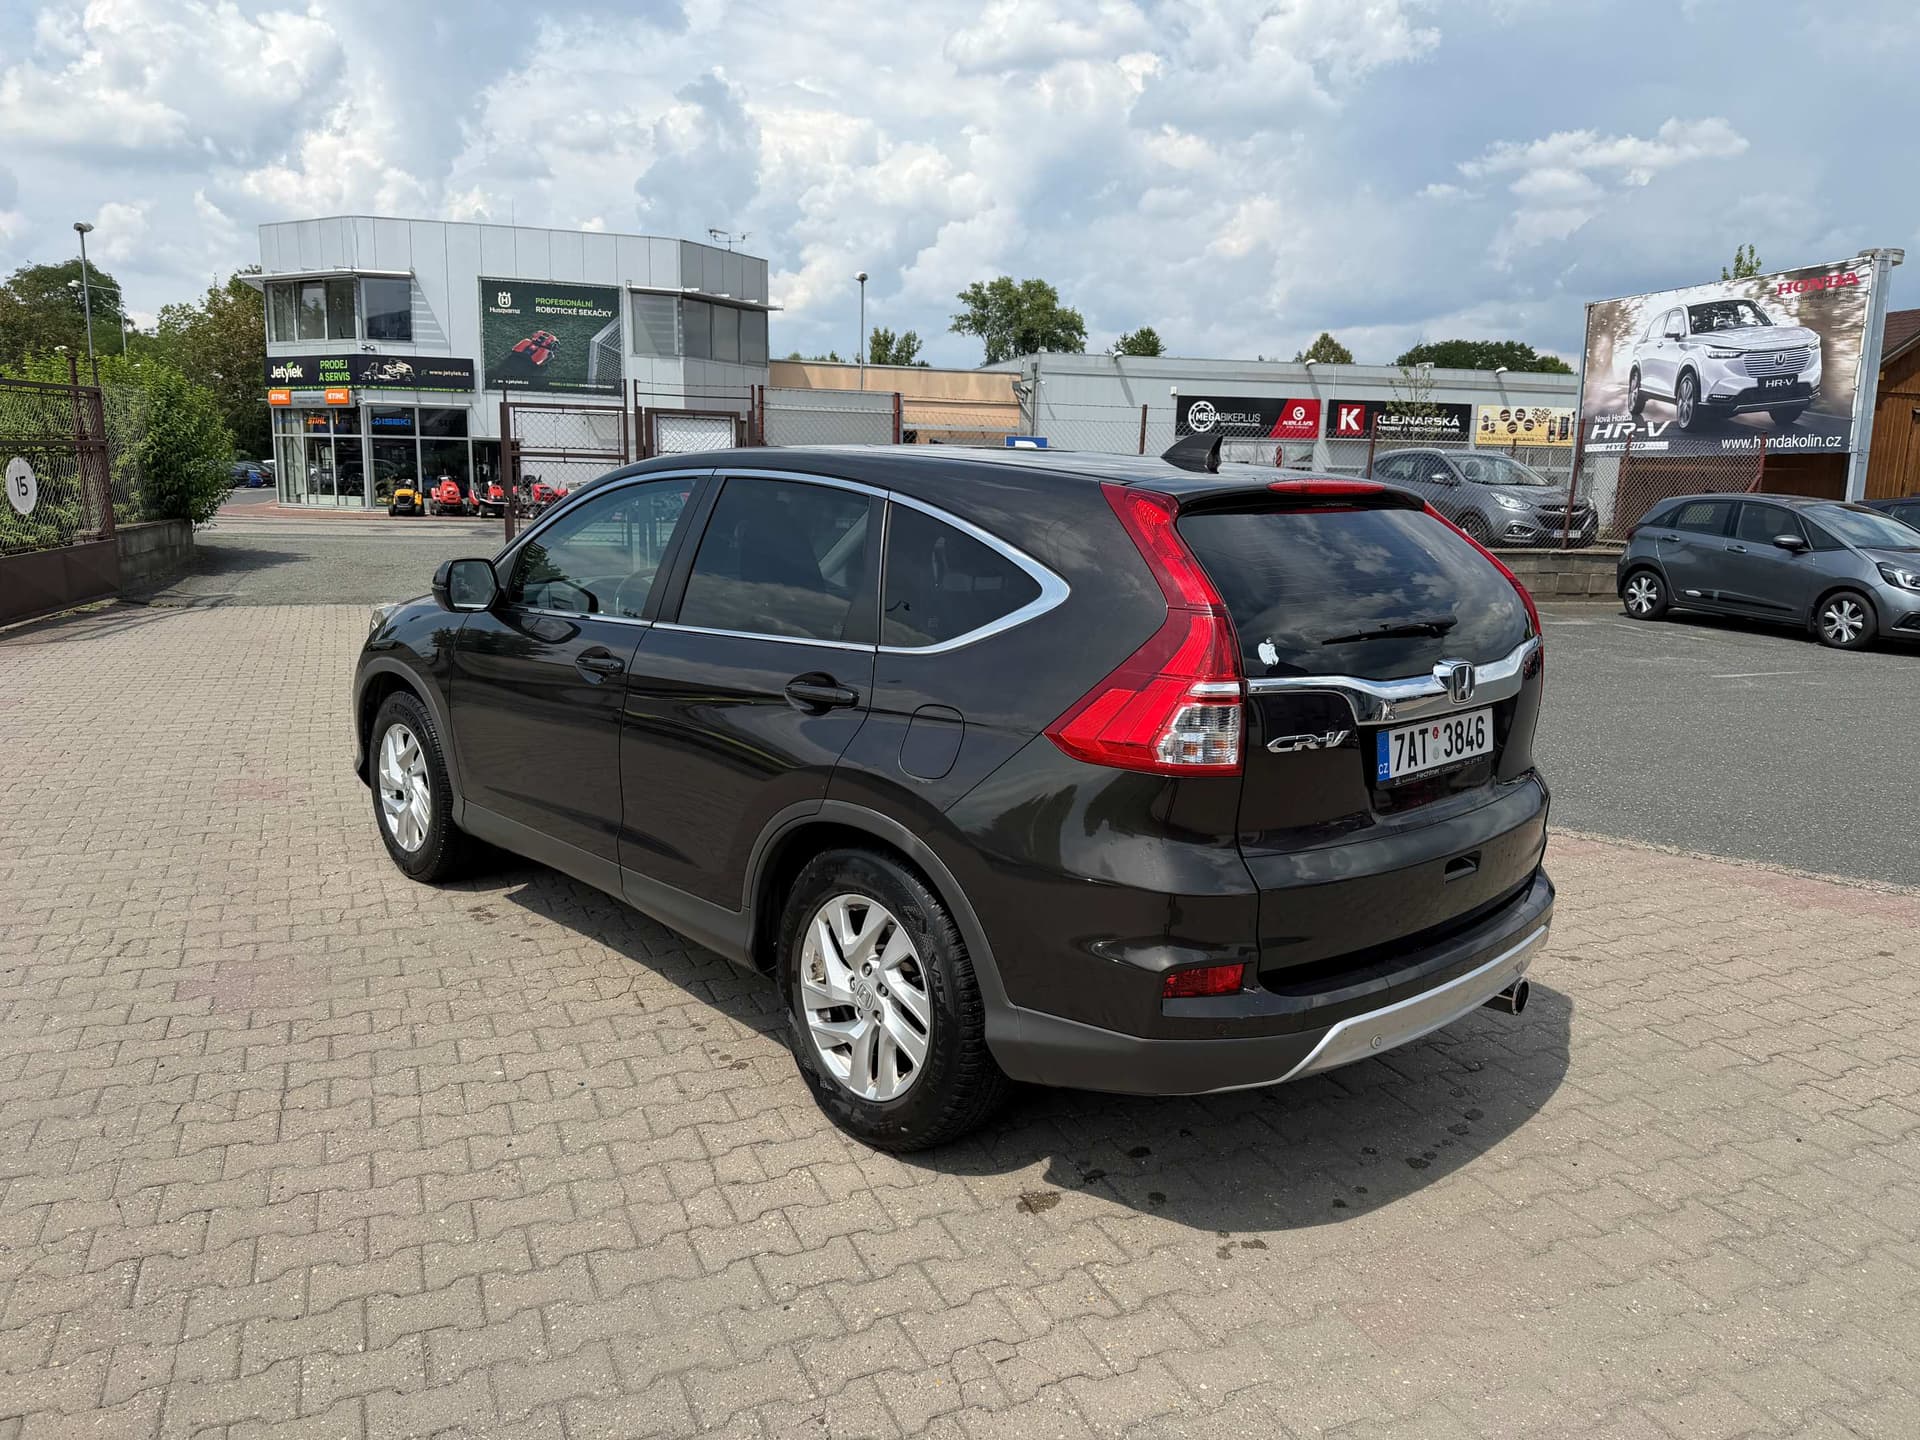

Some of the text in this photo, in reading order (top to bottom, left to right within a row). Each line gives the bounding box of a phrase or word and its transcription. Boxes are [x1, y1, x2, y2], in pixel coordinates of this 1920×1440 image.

[1776, 271, 1860, 296] HONDA
[535, 298, 593, 308] PROFESIONÁLNÍ
[489, 306, 521, 315] Husqvarna
[535, 306, 613, 318] ROBOTICKÉ SEKAČKY
[320, 359, 348, 369] PRODEJ
[318, 371, 351, 382] A SERVIS
[1765, 378, 1794, 388] HR-V
[1195, 412, 1261, 422] MEGABIKEPLUS
[1340, 407, 1361, 431] K
[1594, 413, 1633, 424] Nová Honda
[1590, 420, 1671, 440] HR-V
[1721, 433, 1842, 449] www.hndakolin.cz
[15, 475, 29, 497] 15
[1266, 730, 1350, 753] CR-V
[1394, 715, 1485, 772] 7AT 3846
[1378, 764, 1389, 774] CZ
